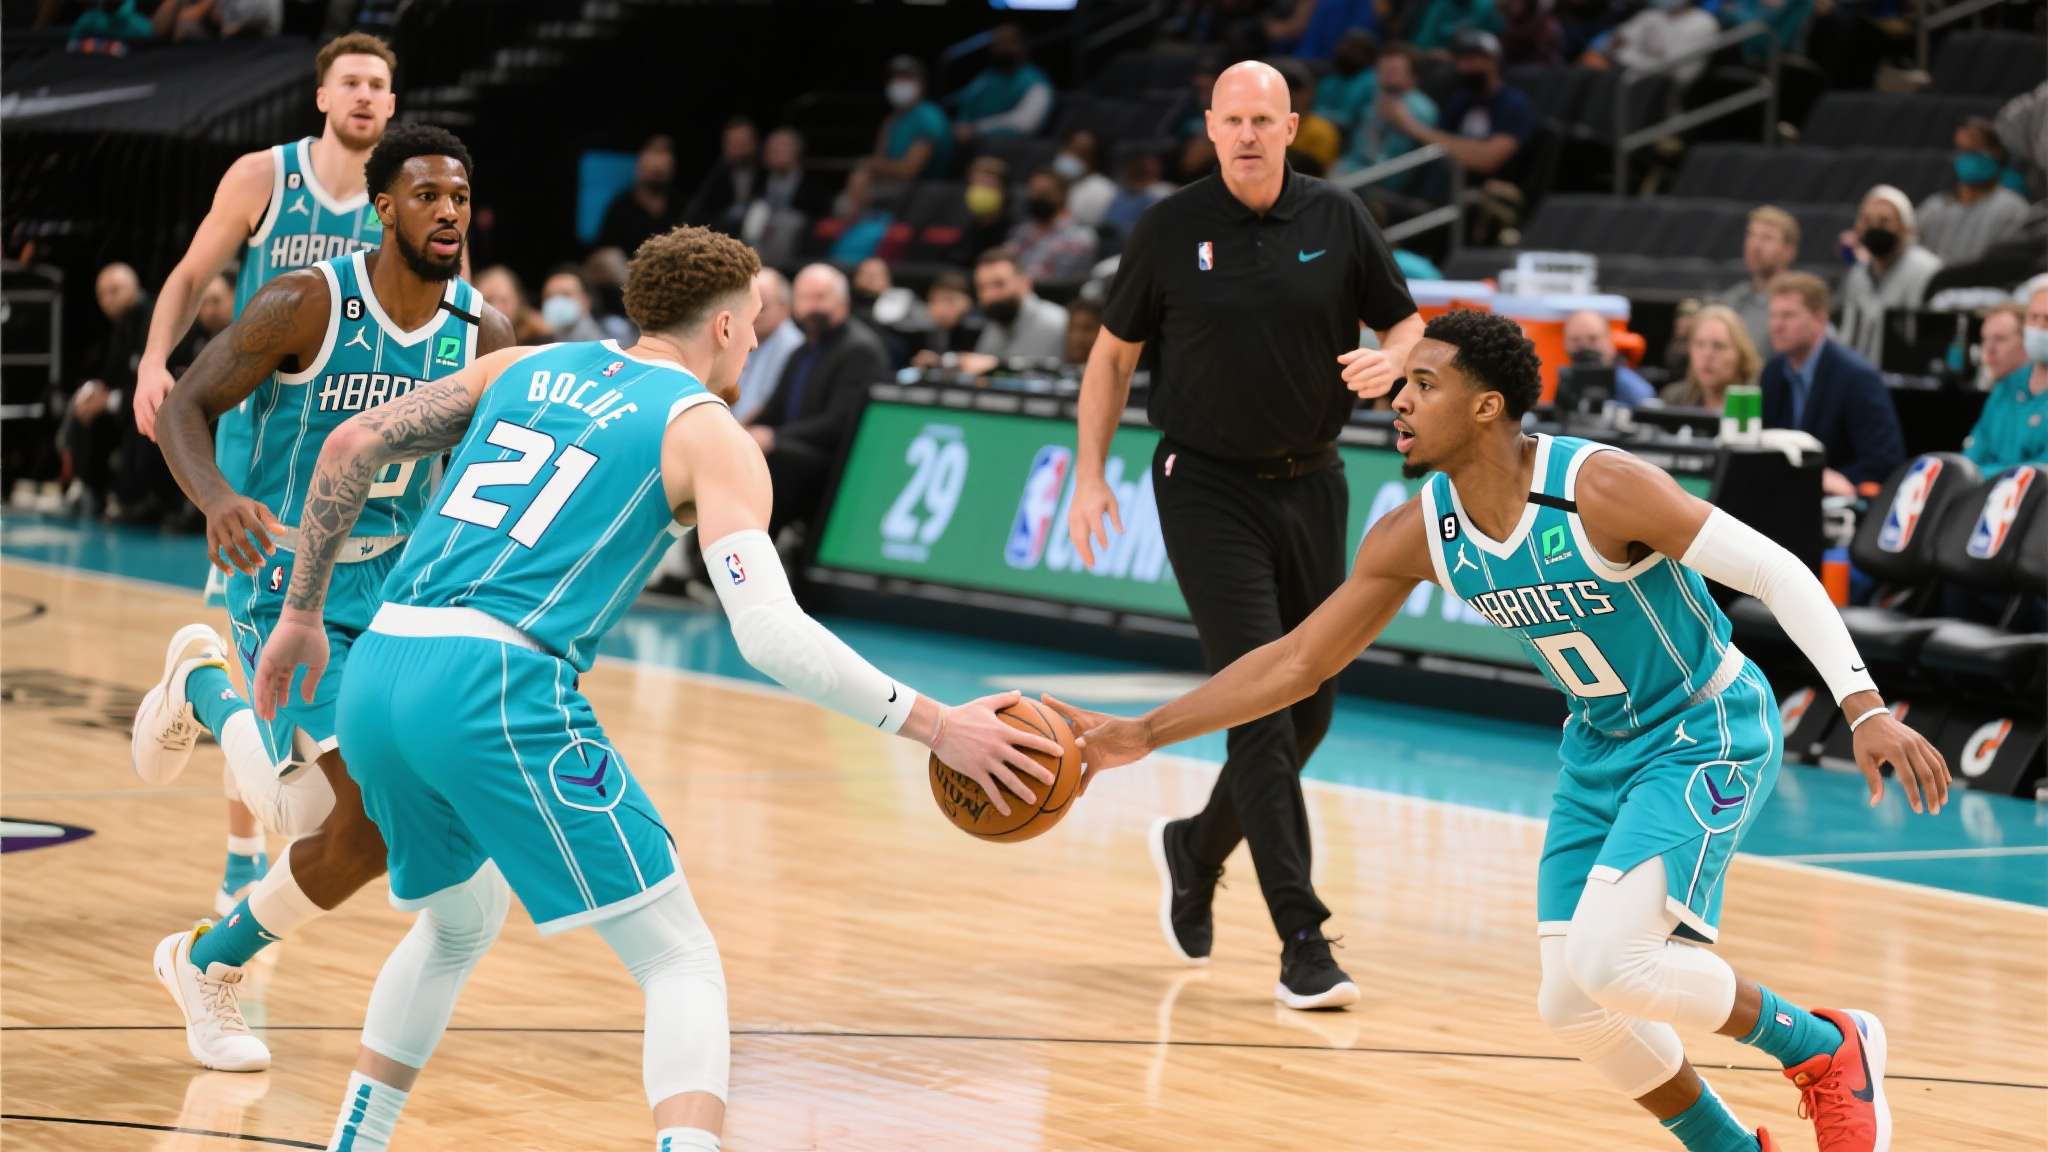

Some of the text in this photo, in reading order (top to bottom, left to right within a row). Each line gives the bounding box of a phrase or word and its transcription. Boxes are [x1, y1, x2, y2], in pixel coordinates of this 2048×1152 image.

[439, 419, 600, 549] 21
[880, 434, 969, 546] 29
[1443, 515, 1457, 539] 9
[1528, 631, 1629, 699] 0
